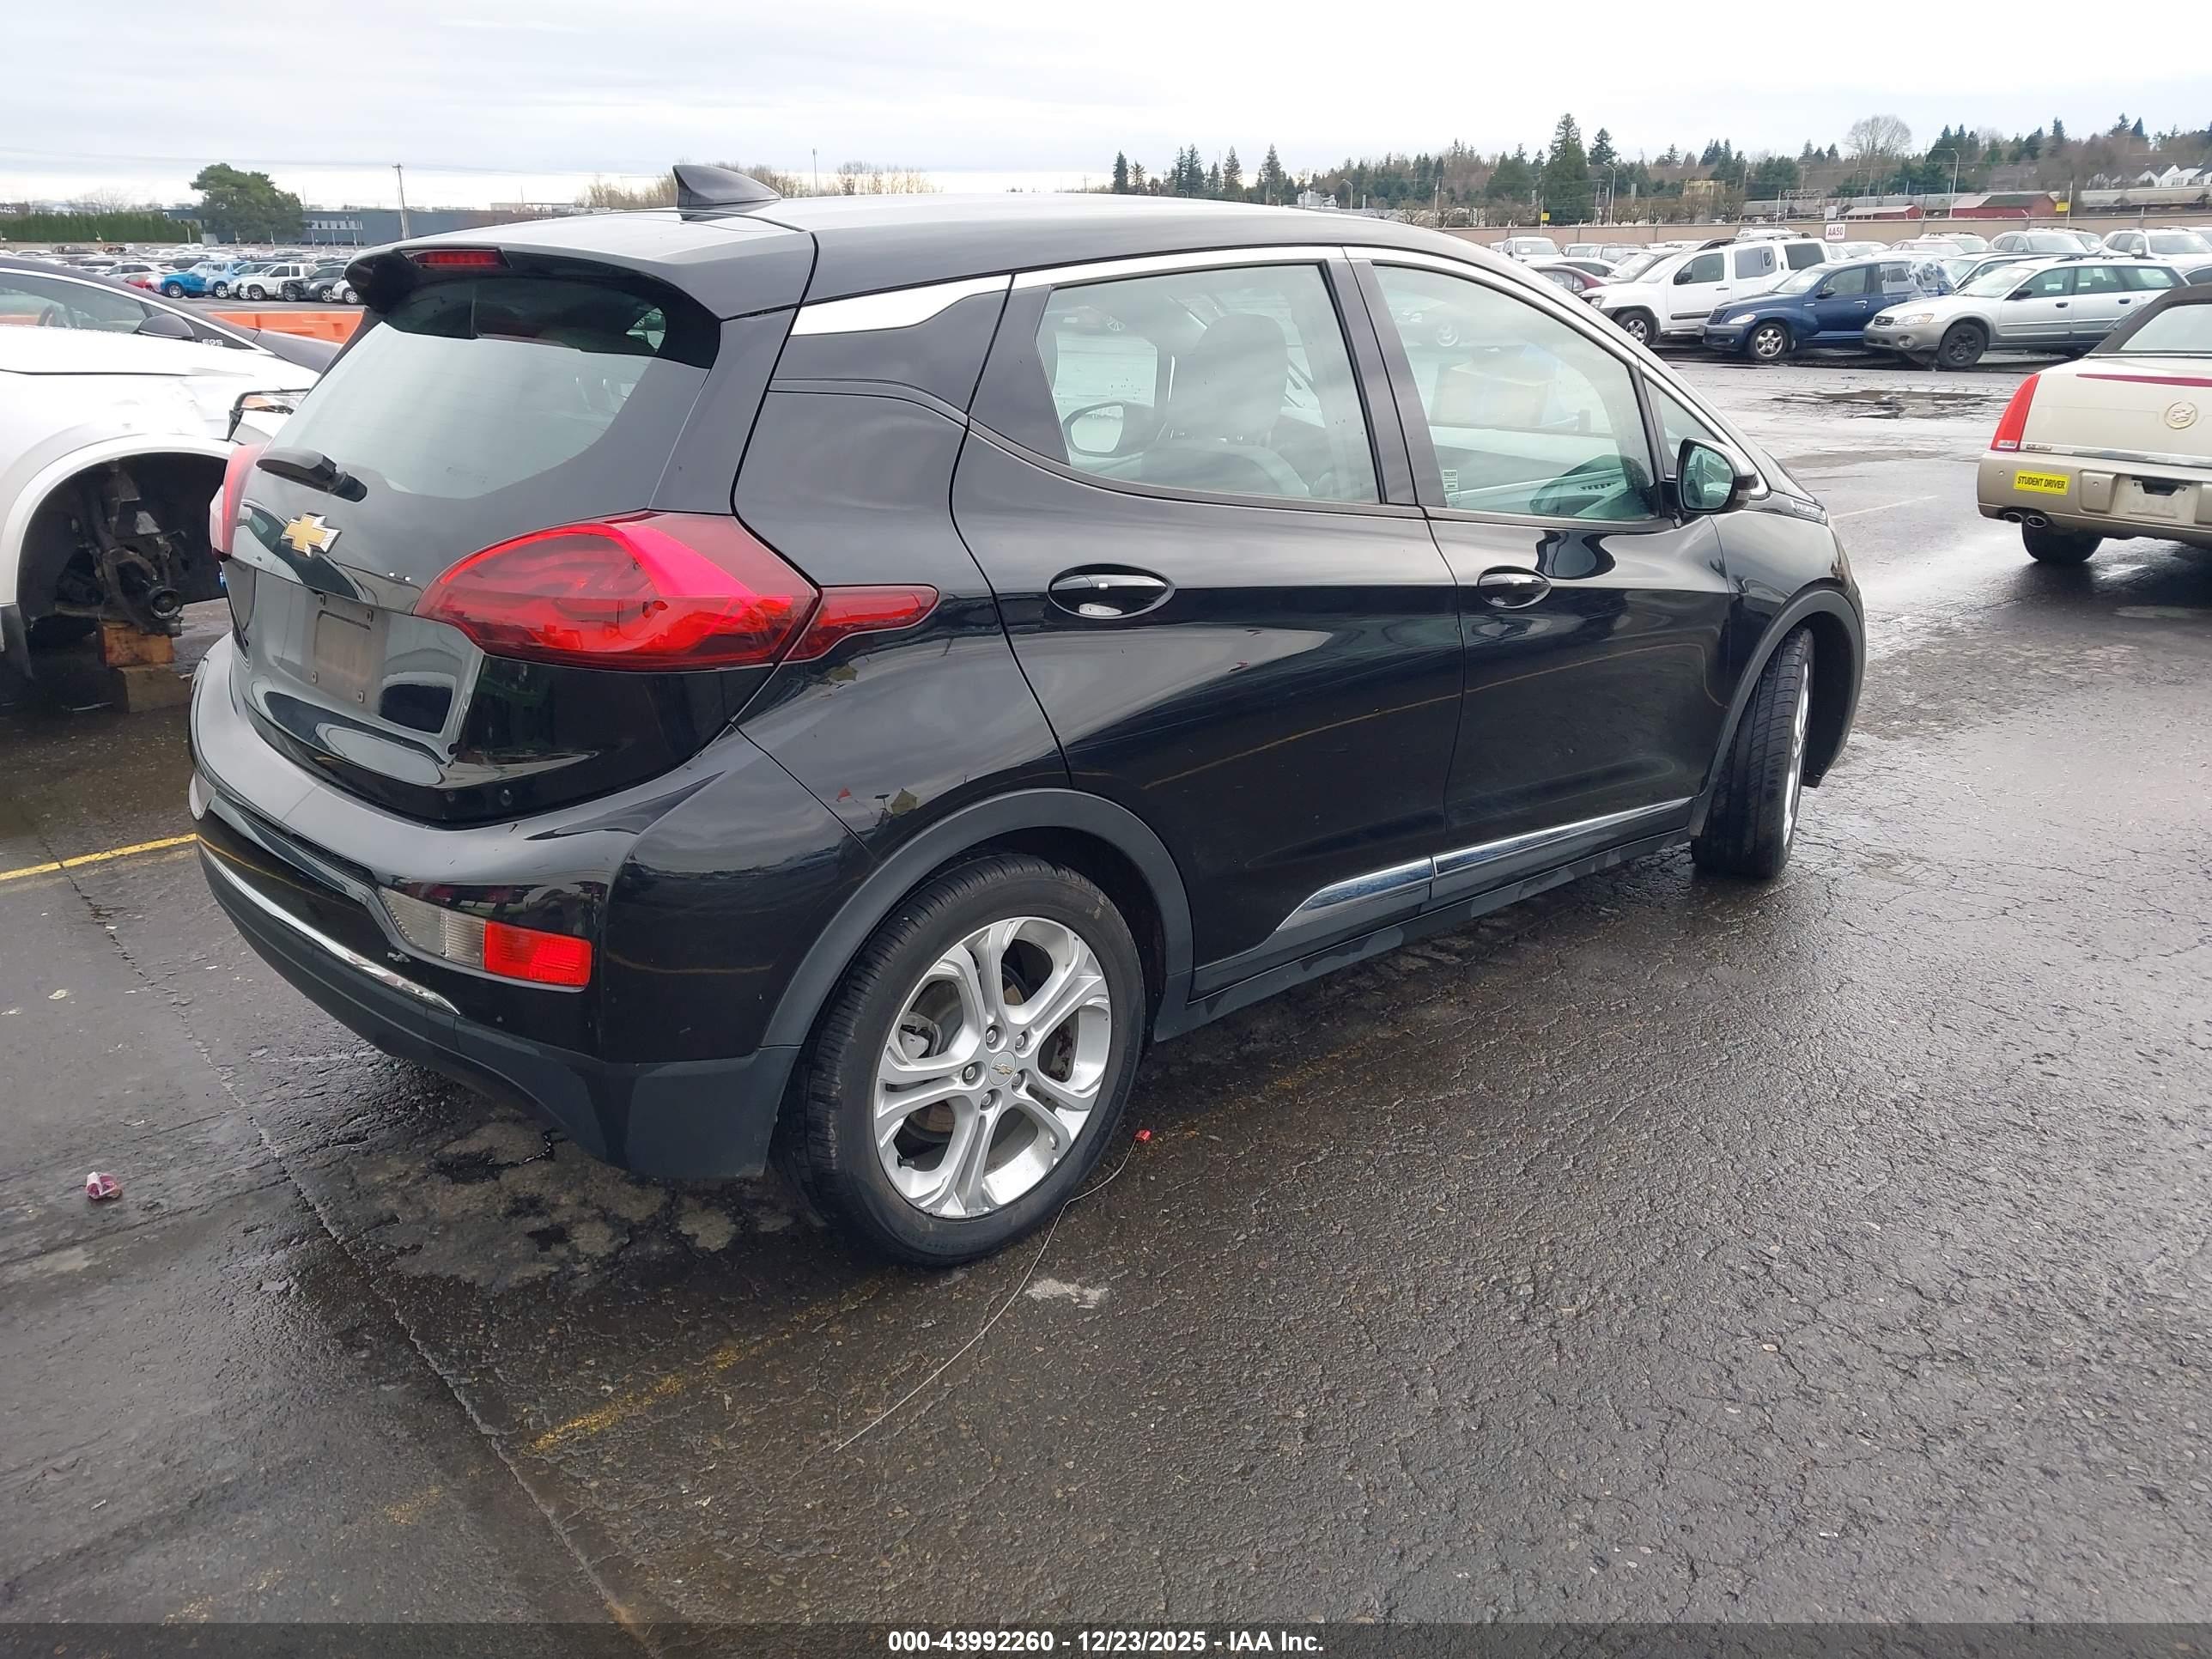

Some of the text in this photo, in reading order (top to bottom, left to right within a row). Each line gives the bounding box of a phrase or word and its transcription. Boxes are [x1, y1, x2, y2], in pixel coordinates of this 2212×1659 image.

[1827, 227, 1844, 236] AA50
[2017, 476, 2066, 489] STUDENT DRIVER
